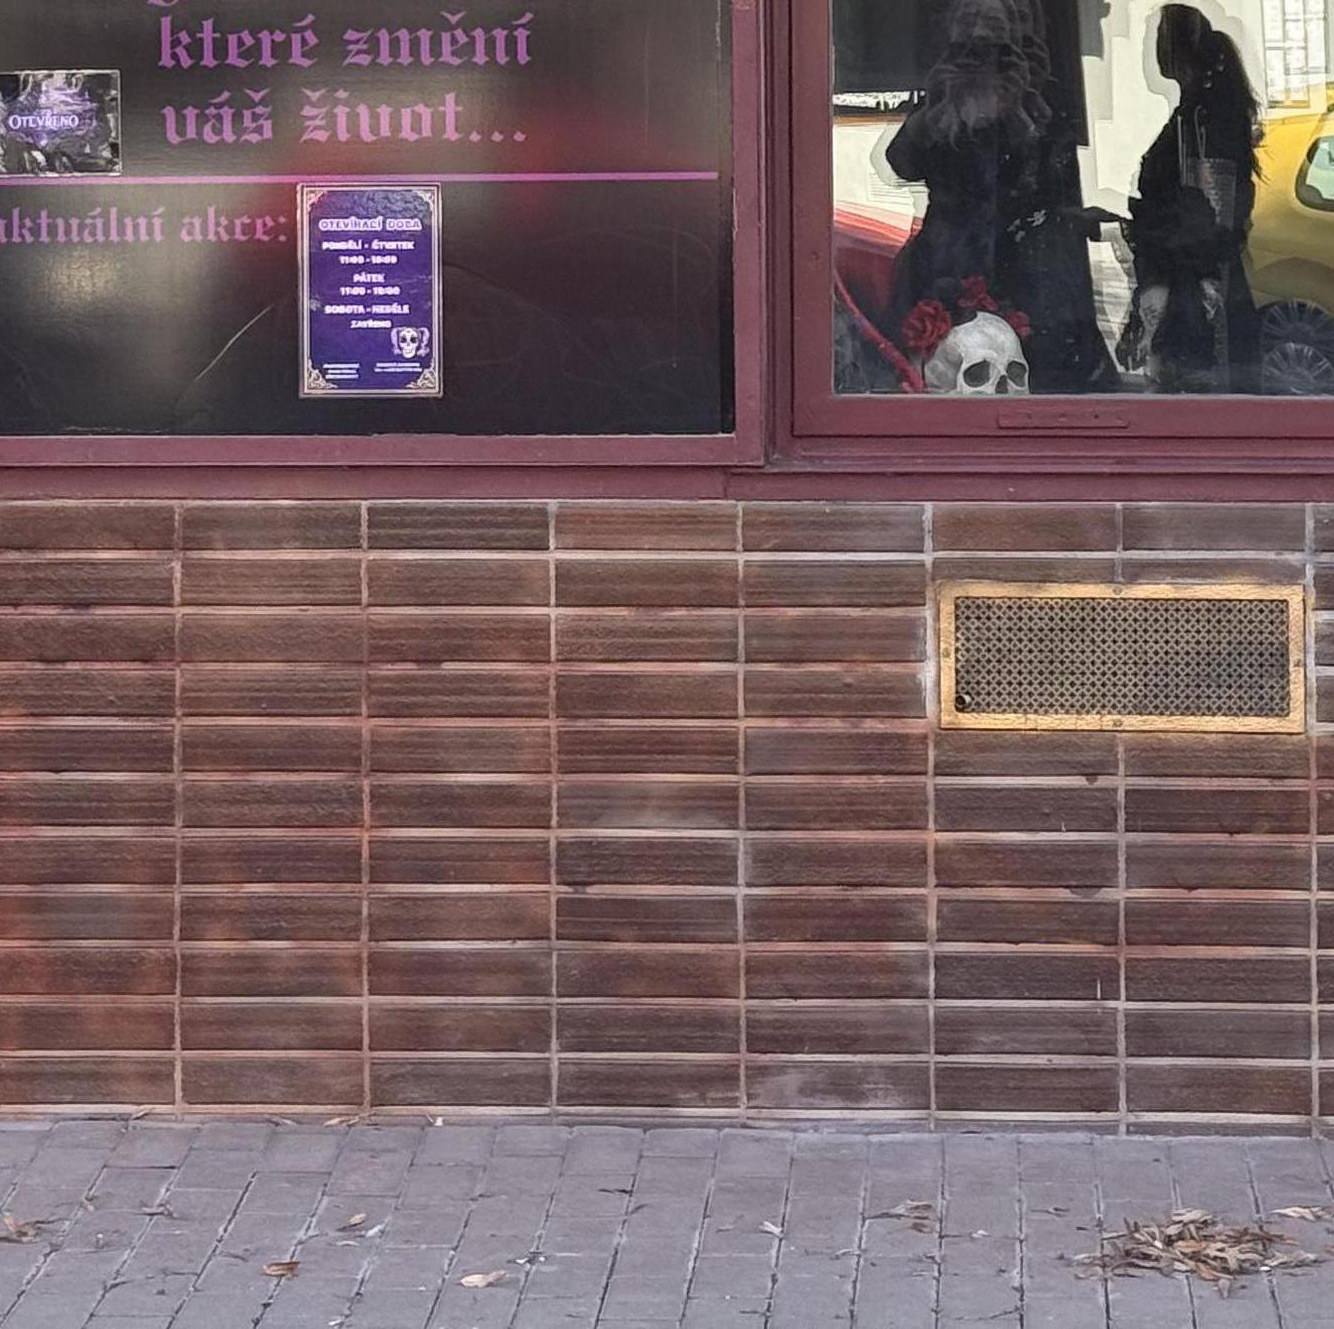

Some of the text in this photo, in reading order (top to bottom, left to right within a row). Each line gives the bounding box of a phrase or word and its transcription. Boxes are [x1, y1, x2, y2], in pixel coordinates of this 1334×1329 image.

[158, 11, 536, 69] které změní
[8, 111, 79, 130] OTEVŘENO
[161, 88, 527, 144] váš život...
[179, 205, 287, 243] akce:
